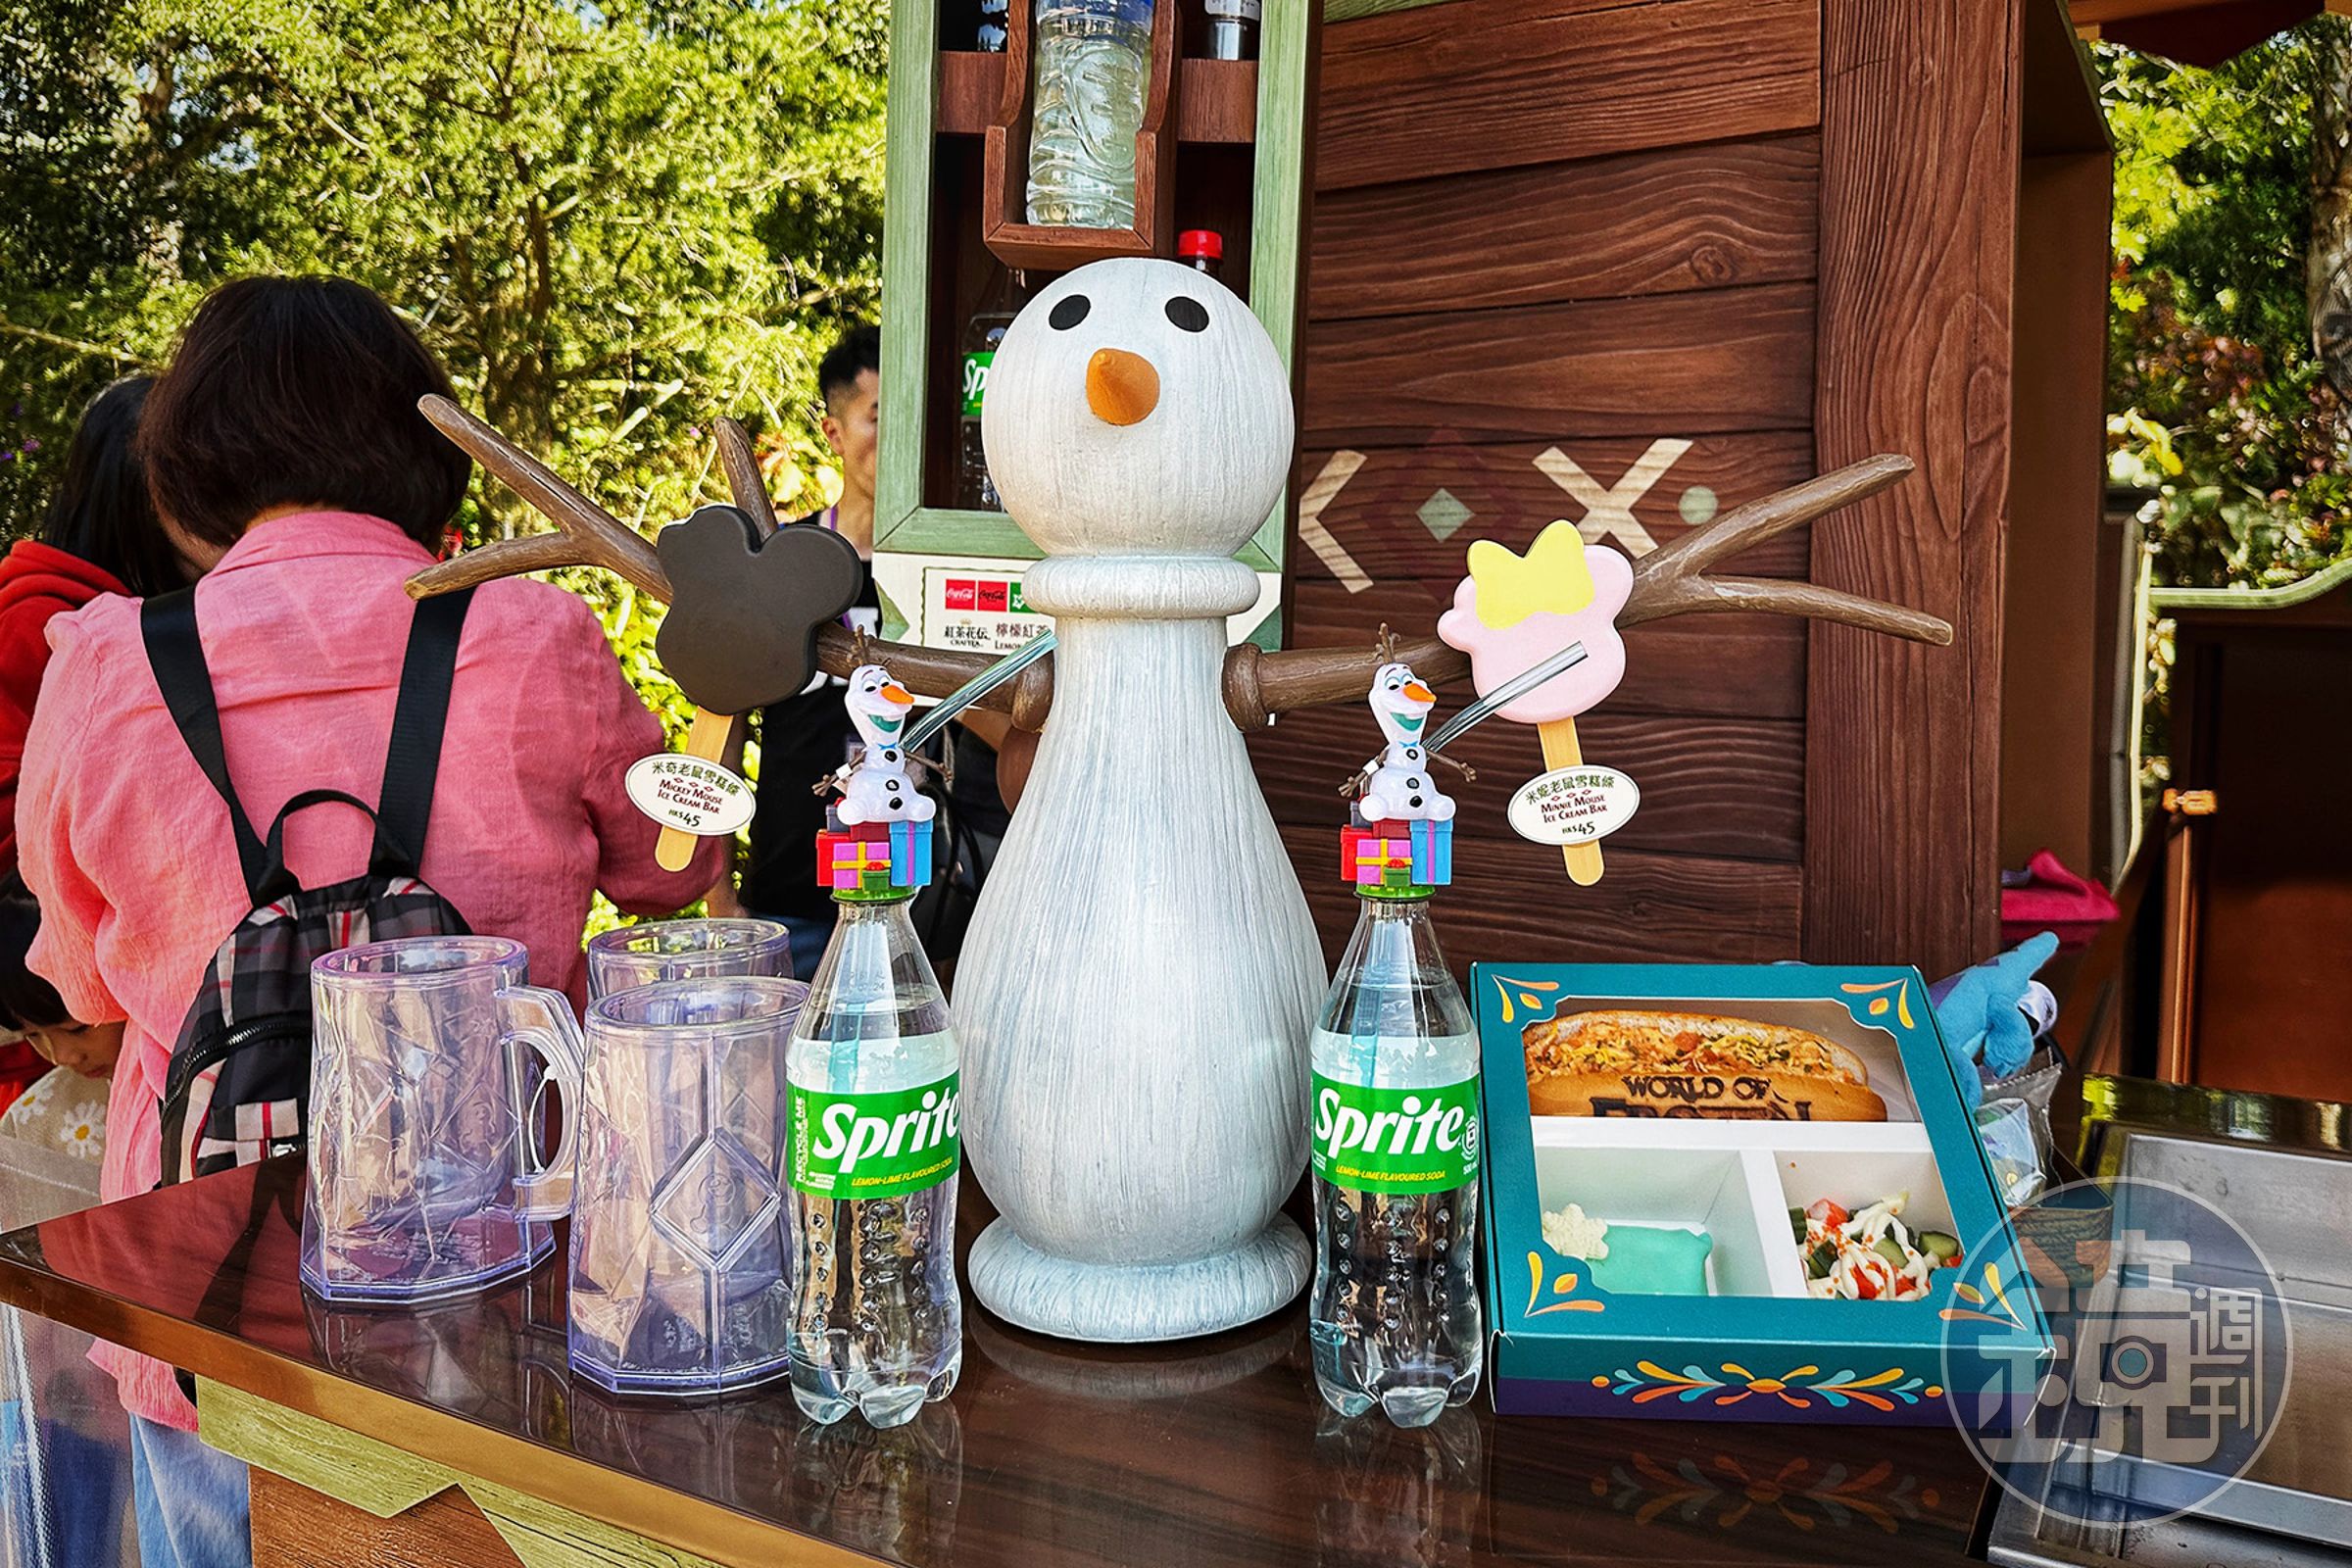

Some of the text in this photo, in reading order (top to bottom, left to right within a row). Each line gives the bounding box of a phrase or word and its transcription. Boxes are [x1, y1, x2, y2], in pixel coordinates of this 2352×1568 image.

[1315, 1088, 1464, 1160] Sprite
[1621, 1075, 1772, 1102] WORLD OF
[812, 1087, 959, 1174] Sprite
